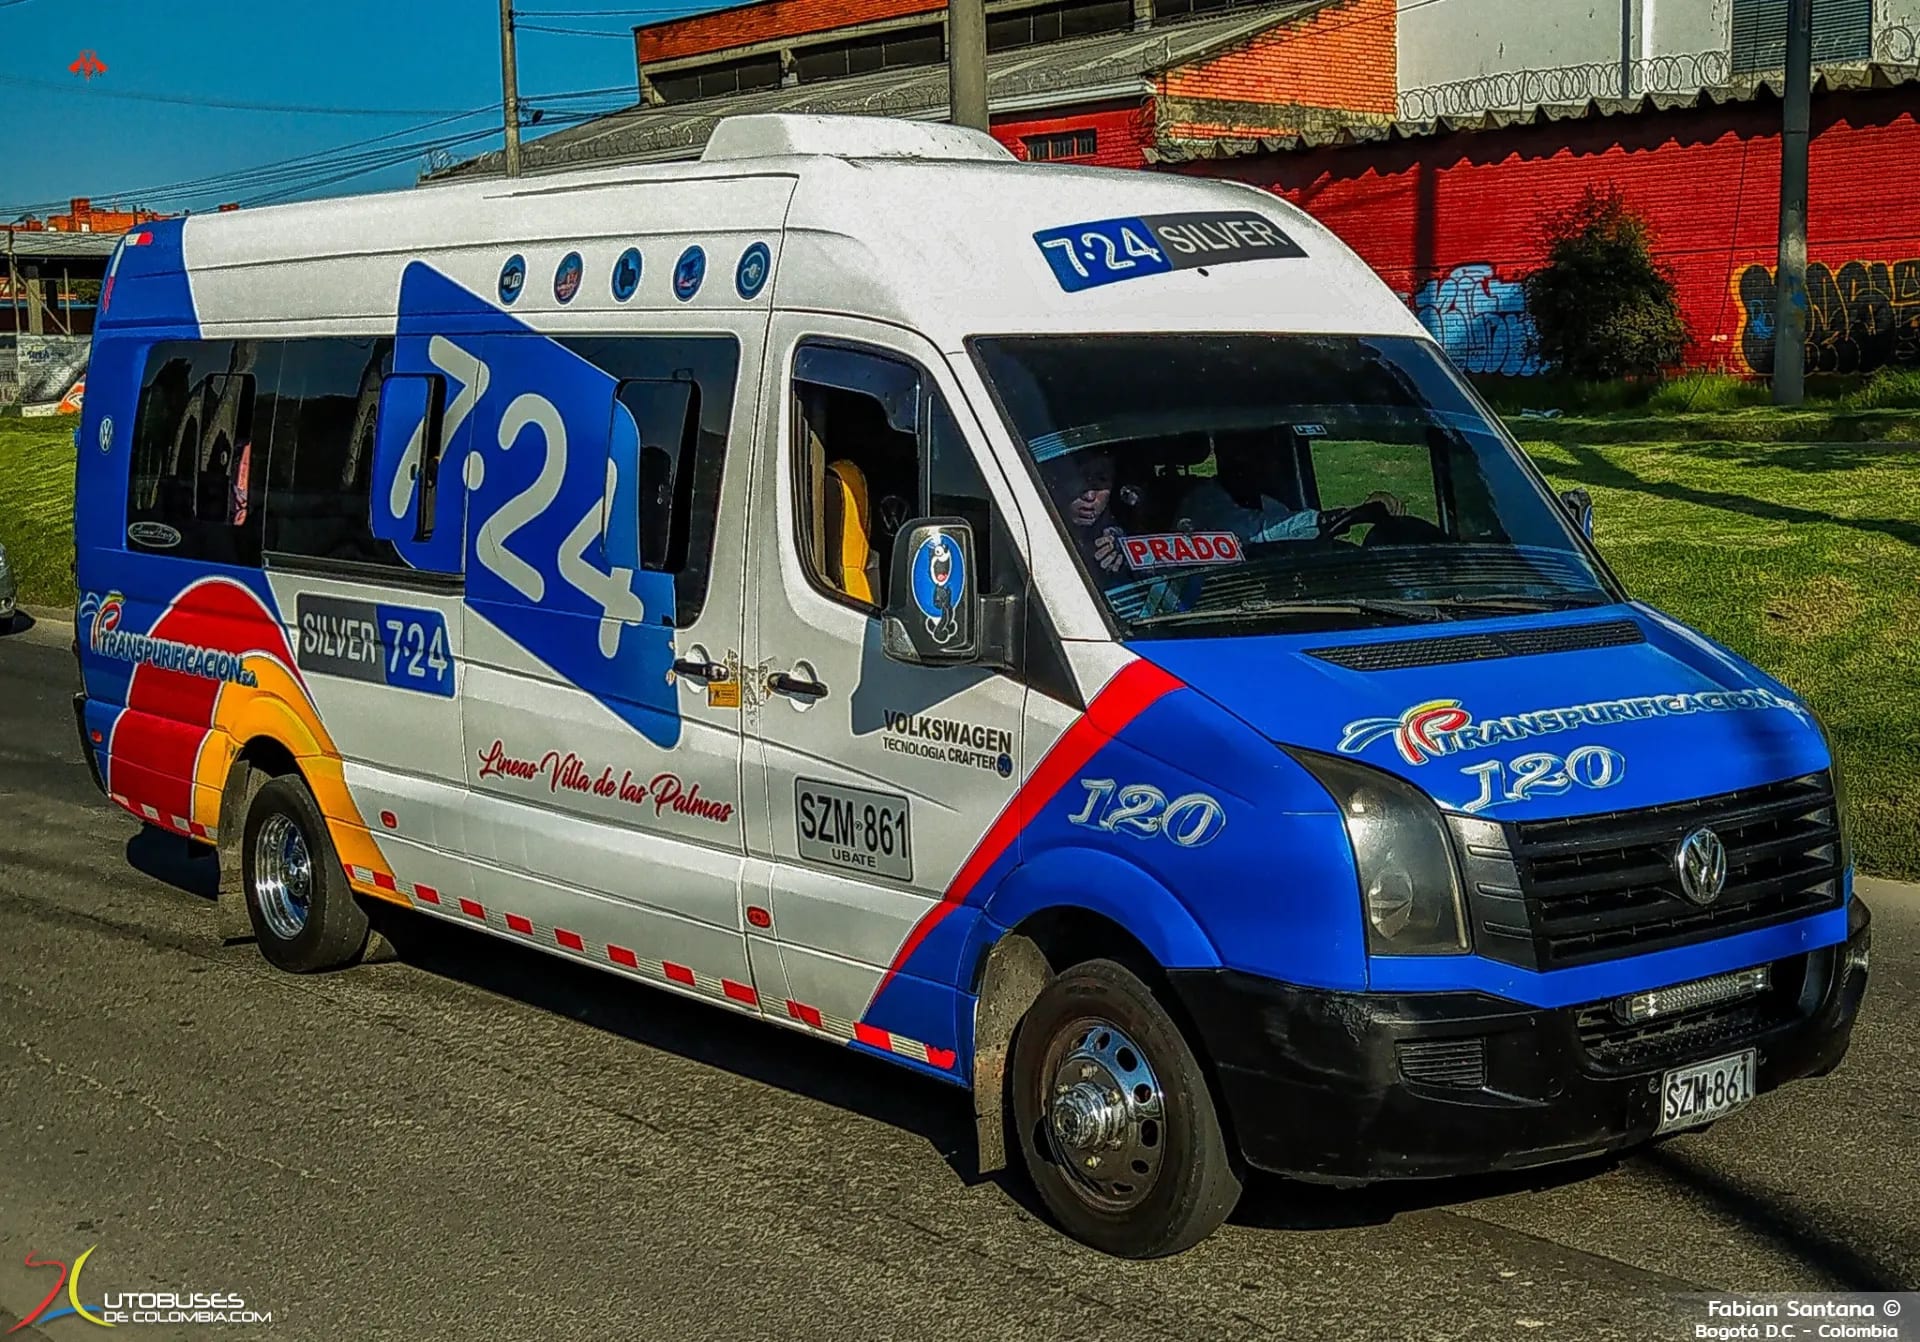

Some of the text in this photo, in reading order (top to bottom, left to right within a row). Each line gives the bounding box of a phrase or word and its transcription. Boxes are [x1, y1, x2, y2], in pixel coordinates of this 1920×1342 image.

[1158, 220, 1289, 254] SILVER
[1127, 536, 1237, 564] PRADO
[99, 630, 244, 682] TRANSPURIFICACION
[303, 613, 376, 664] SILVER
[884, 709, 1012, 754] VOLKSWAGEN
[1432, 687, 1784, 753] TRANSPURIFICACION
[882, 736, 946, 761] TECNOLOGIA
[948, 747, 996, 771] CRAFTER
[1460, 745, 1626, 812] 120
[478, 740, 735, 822] Lineas Villa de las Palmas
[1067, 779, 1227, 848] 120
[832, 848, 877, 868] UBATE
